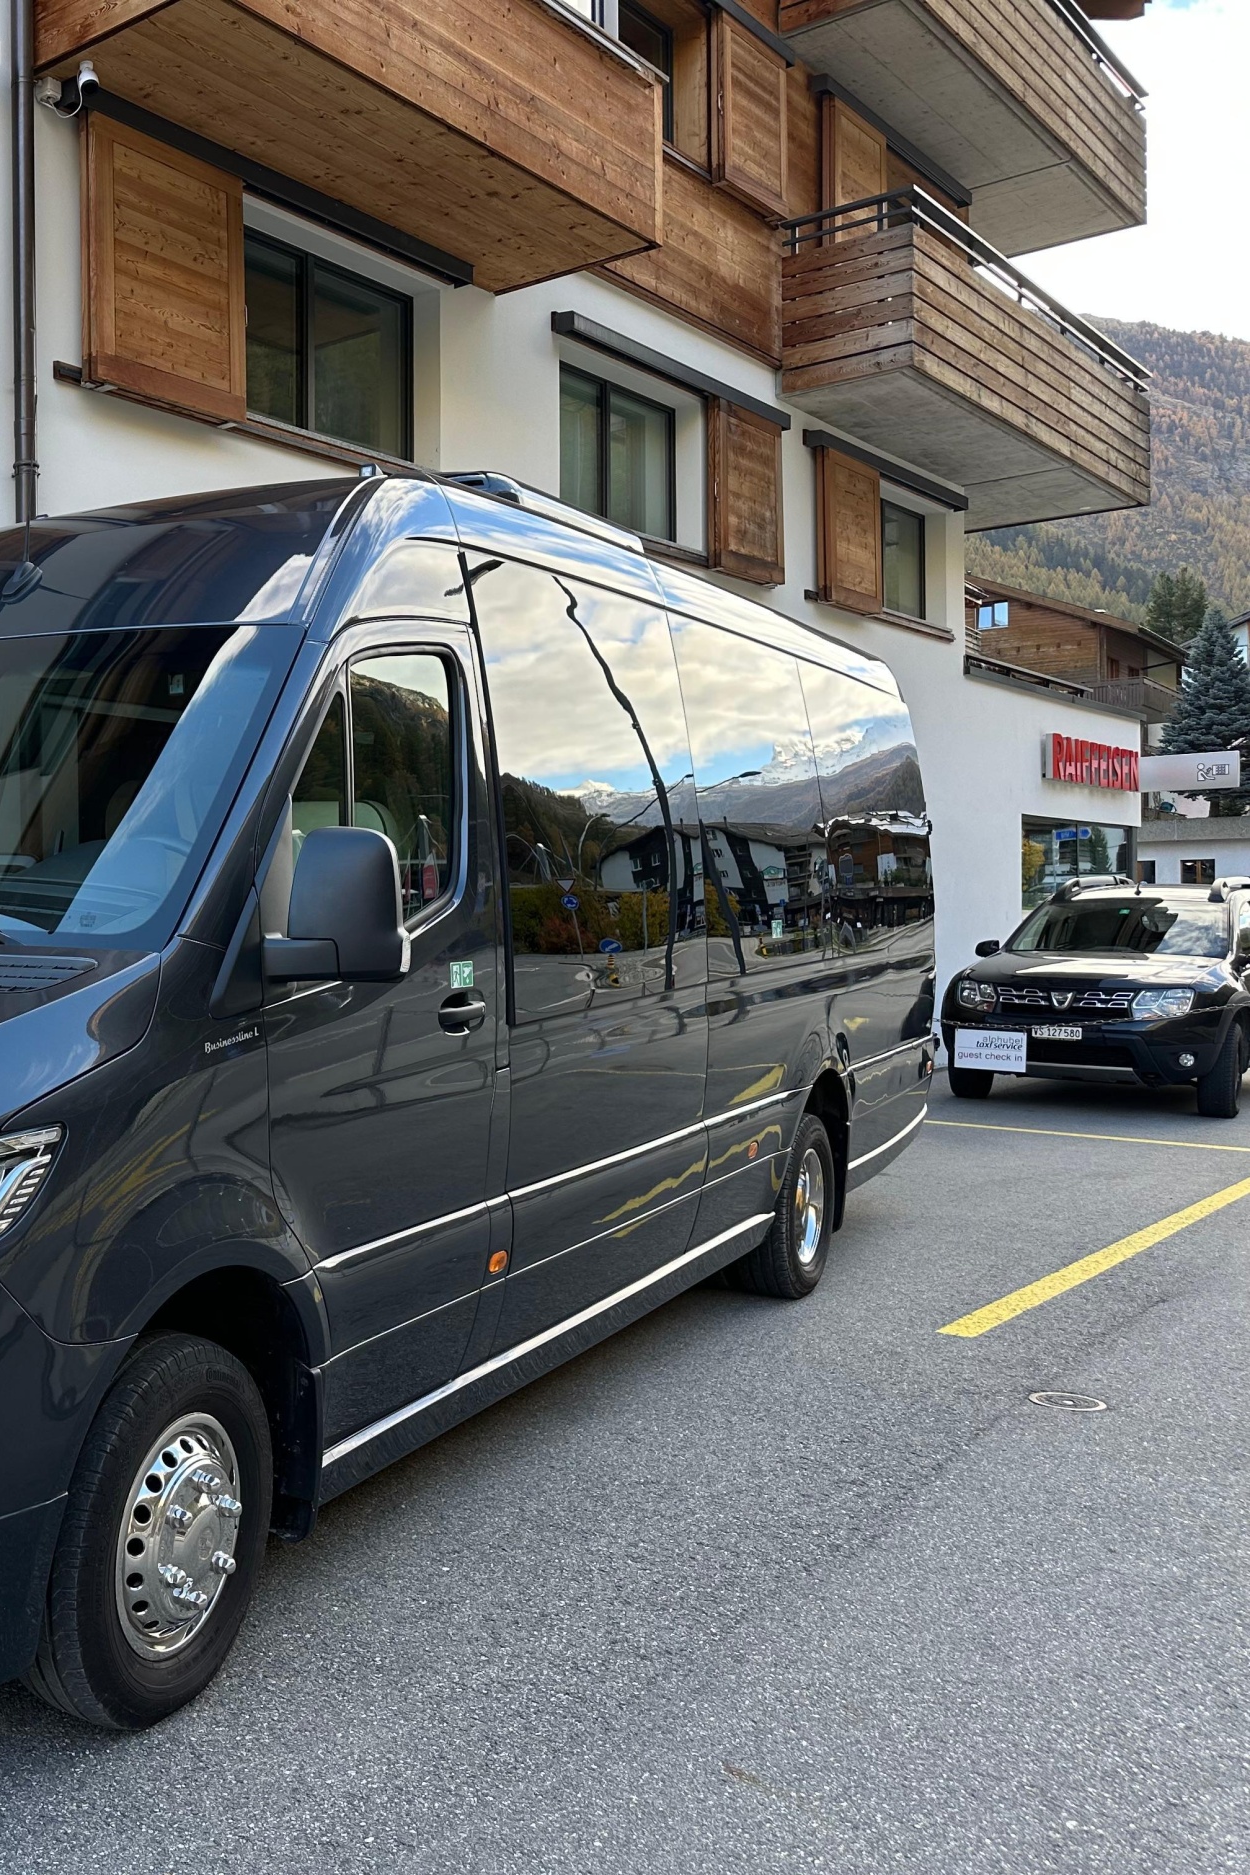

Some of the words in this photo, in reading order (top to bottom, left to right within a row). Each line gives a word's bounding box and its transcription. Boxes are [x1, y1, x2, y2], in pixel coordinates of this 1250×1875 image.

[1052, 733, 1140, 792] RAIFFEISEN
[1047, 1027, 1081, 1038] 127580
[204, 1031, 253, 1053] Businessline
[993, 1042, 1023, 1051] service
[957, 1051, 982, 1060] guest
[985, 1051, 1012, 1061] check
[1014, 1054, 1023, 1062] in
